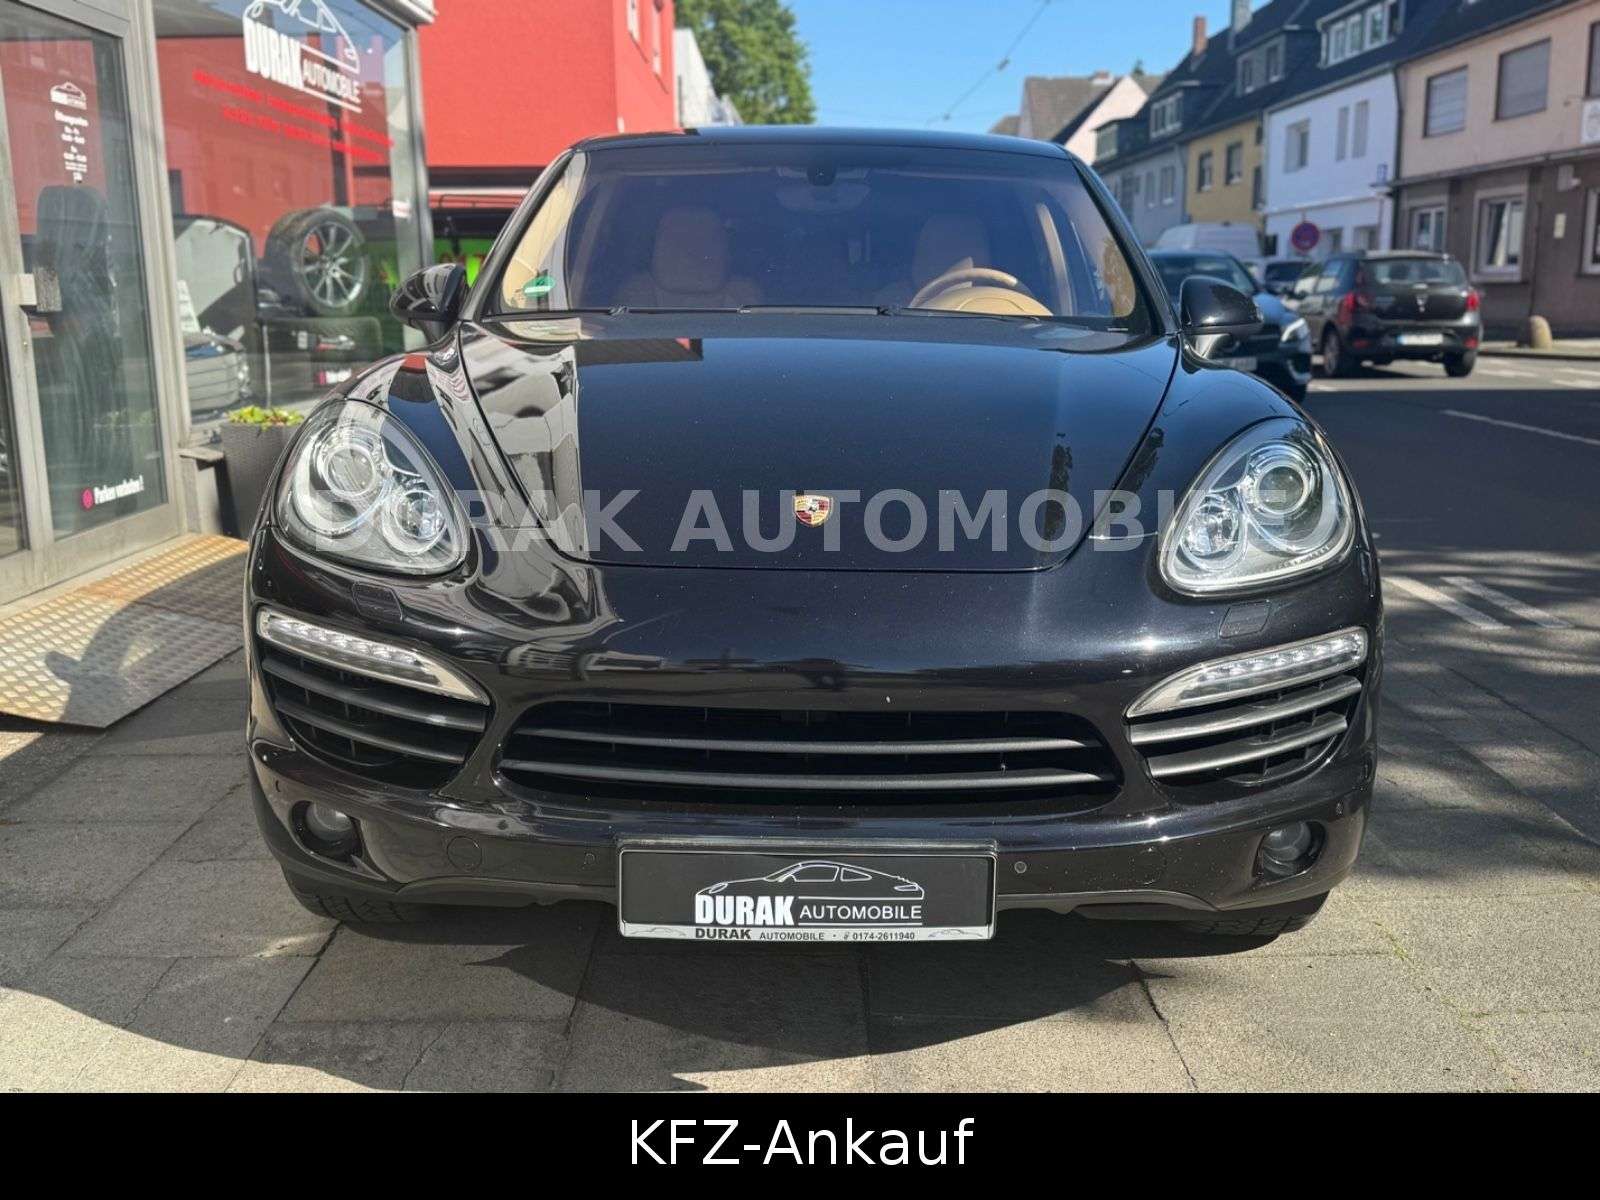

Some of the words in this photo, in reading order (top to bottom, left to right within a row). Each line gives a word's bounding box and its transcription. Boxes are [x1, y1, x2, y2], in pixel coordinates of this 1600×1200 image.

[243, 15, 304, 91] DURAK
[303, 58, 362, 105] AUTOMOBILE
[694, 895, 795, 927] DURAK
[799, 904, 923, 921] AUTOMOBILE
[694, 927, 752, 941] DURAK
[759, 931, 826, 942] AUTOMOBILE
[852, 931, 916, 942] 0174-2611940
